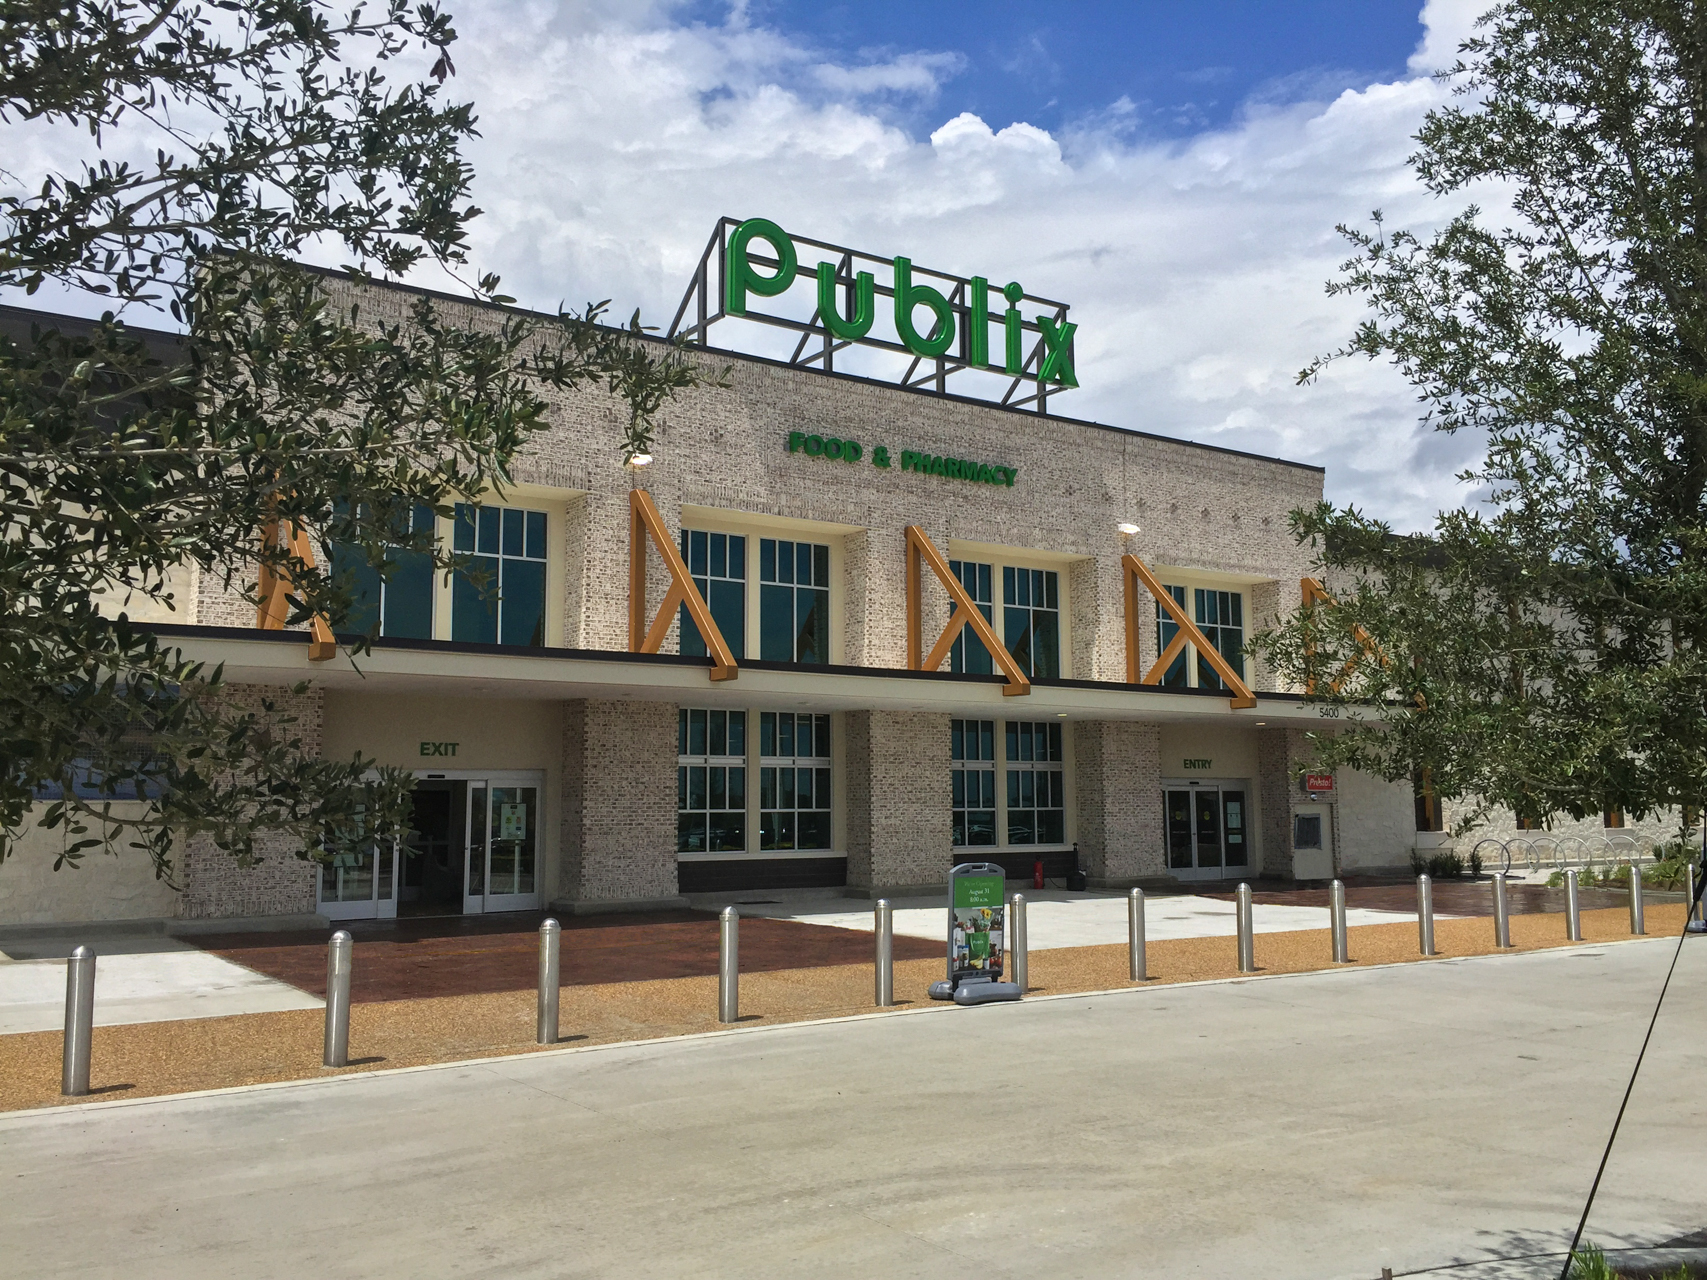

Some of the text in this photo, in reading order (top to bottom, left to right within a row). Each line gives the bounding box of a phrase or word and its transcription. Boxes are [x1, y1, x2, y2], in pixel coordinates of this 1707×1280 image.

[726, 218, 1079, 389] Publix
[789, 431, 1018, 487] FOOD & PHARMACY
[1319, 707, 1340, 718] 5400
[420, 742, 459, 756] EXIT
[1183, 758, 1213, 769] ENTRY
